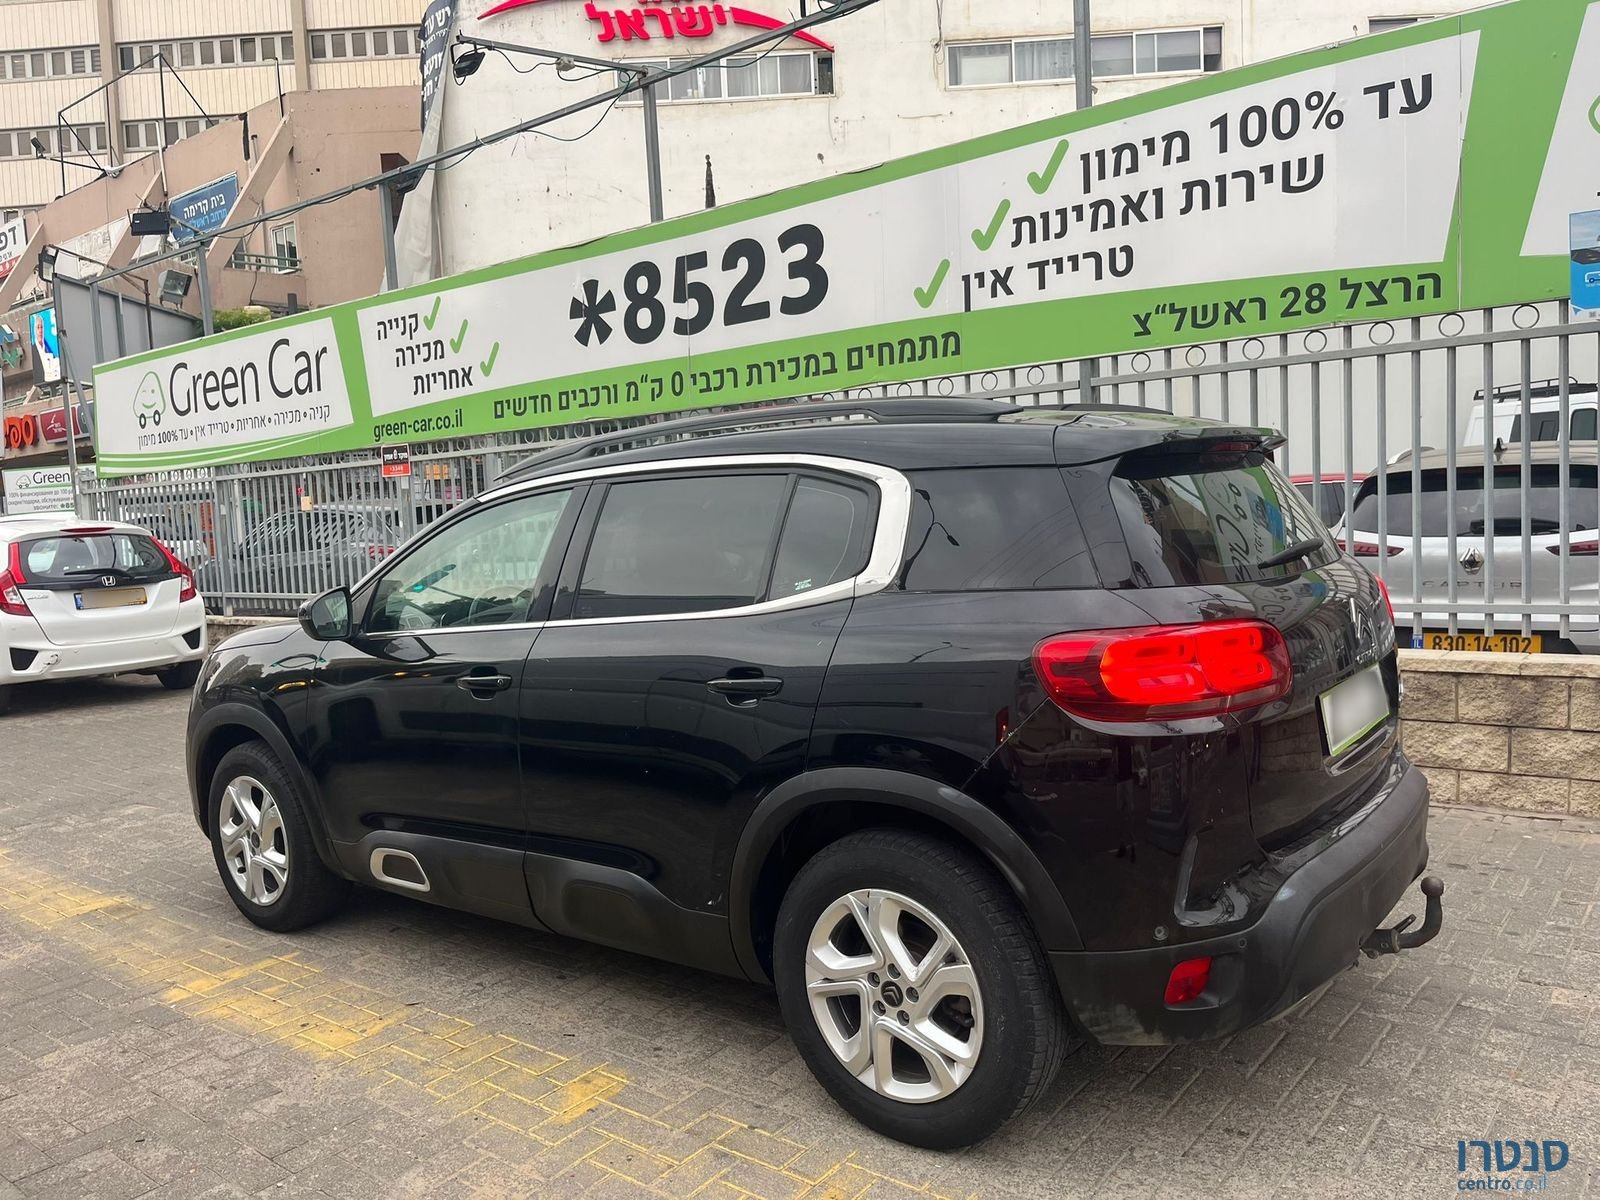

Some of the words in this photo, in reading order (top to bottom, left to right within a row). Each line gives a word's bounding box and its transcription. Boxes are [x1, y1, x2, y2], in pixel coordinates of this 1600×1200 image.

[584, 3, 727, 42] ישראל
[1363, 73, 1434, 119] עד
[1210, 90, 1345, 154] 100%
[1079, 129, 1190, 194] מימון
[1180, 153, 1325, 216] שירות
[183, 199, 209, 220] קדימה
[210, 193, 226, 209] בית
[1011, 187, 1164, 249] ואמינות
[1027, 245, 1135, 292] טרייד
[961, 265, 1014, 312] אין
[1279, 283, 1327, 319] 28
[1339, 272, 1442, 310] הרצל
[377, 313, 419, 341] קנייה
[395, 339, 445, 368] מכירה
[847, 331, 962, 371] מתמחים
[169, 361, 261, 417] Green
[268, 338, 328, 399] Car
[413, 366, 473, 396] אחריות
[690, 366, 739, 395] רכבי
[746, 351, 838, 387] במכירת
[670, 370, 685, 398] 0
[309, 404, 331, 423] קניה
[493, 392, 552, 420] חדשים
[558, 387, 619, 412] ורכבים
[208, 421, 230, 437] טרייד
[236, 415, 266, 432] אחריות
[273, 409, 301, 426] מכירה
[373, 408, 463, 442] green-car.co.il
[138, 433, 156, 450] מימון
[158, 429, 178, 444] 100%
[179, 427, 189, 441] עד
[194, 425, 206, 441] אין
[32, 471, 70, 485] Green
